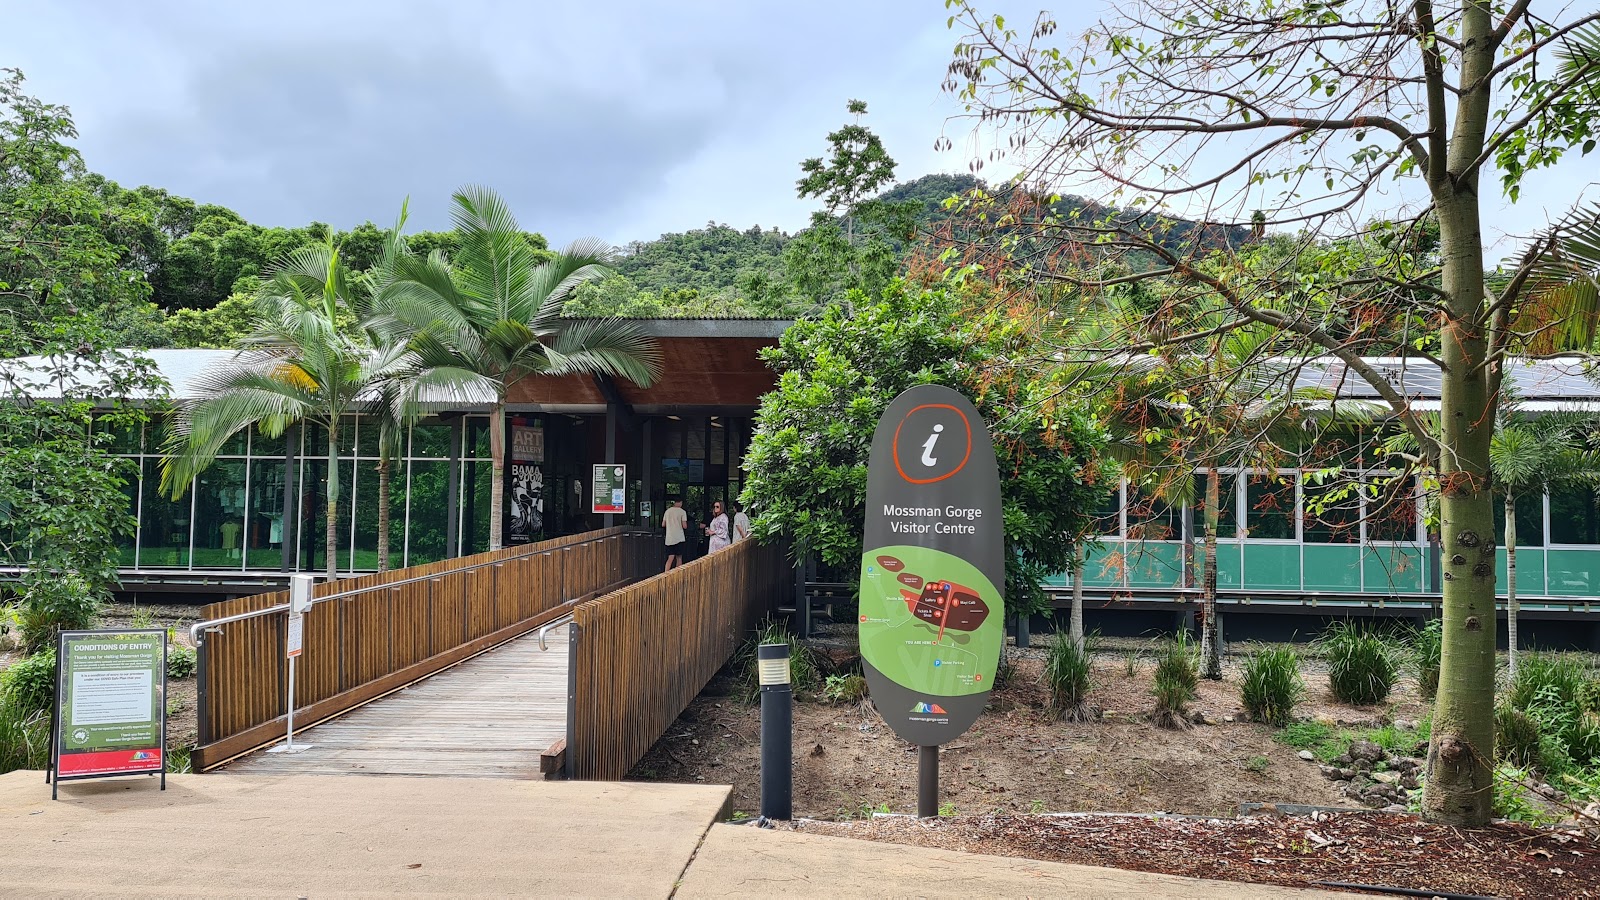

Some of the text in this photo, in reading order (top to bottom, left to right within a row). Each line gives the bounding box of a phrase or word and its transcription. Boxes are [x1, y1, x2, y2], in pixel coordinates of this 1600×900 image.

[514, 430, 542, 446] ART
[514, 446, 542, 454] GALLERY
[512, 465, 540, 475] BAMA
[884, 504, 982, 520] Mossman Gorge
[890, 522, 975, 534] Visitor Centre
